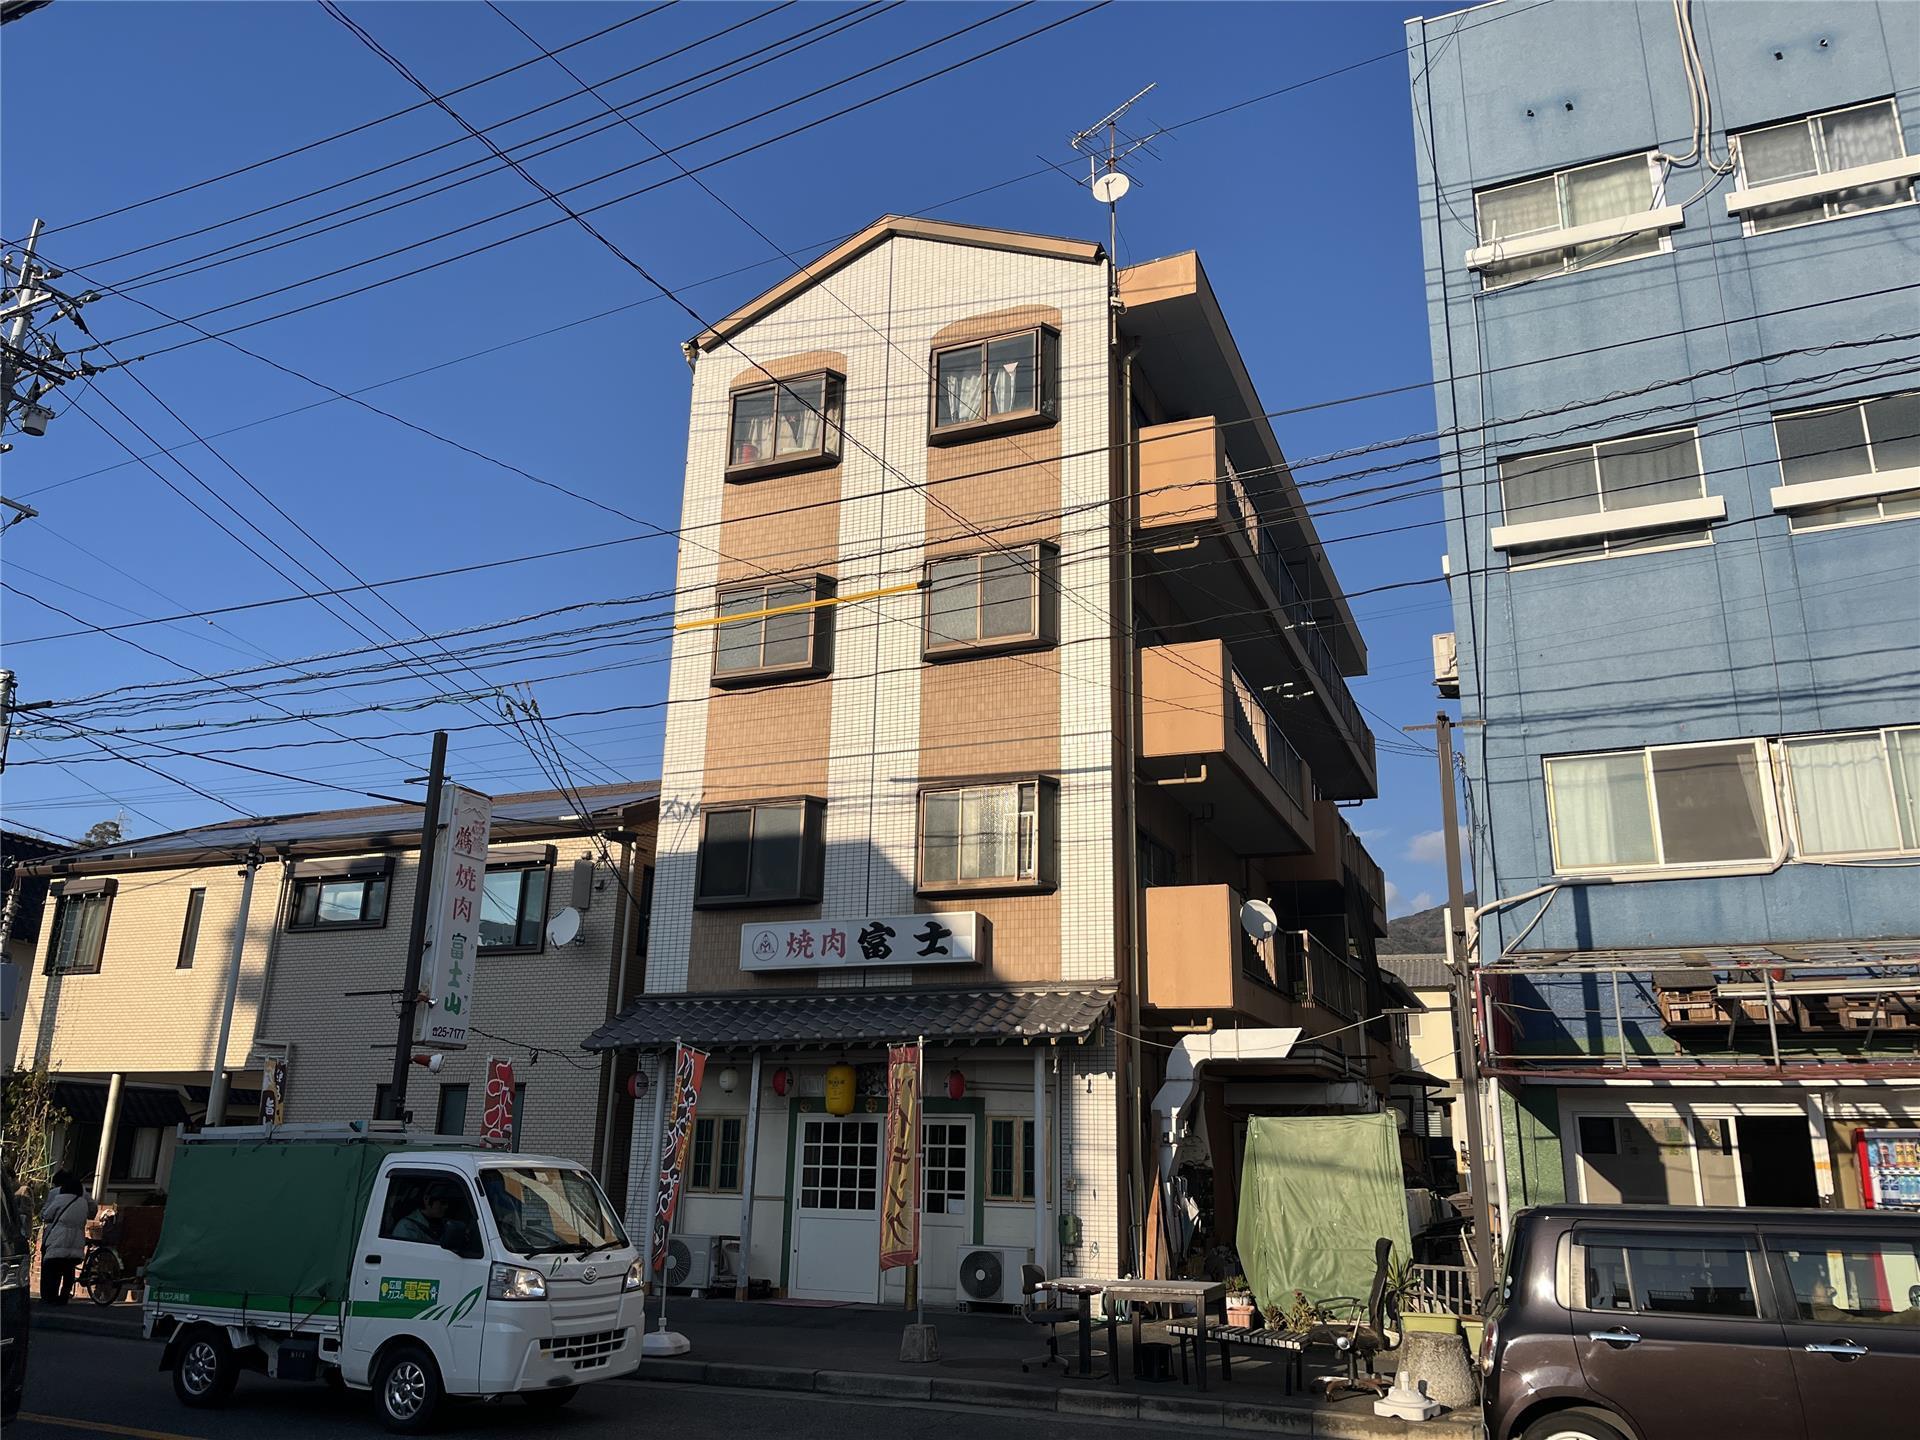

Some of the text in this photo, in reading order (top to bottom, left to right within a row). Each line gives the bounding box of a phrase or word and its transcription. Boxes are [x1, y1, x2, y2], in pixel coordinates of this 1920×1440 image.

[785, 921, 953, 960] 焼肉 富士
[444, 932, 467, 1016] 富士山
[404, 1280, 432, 1302] 電気
